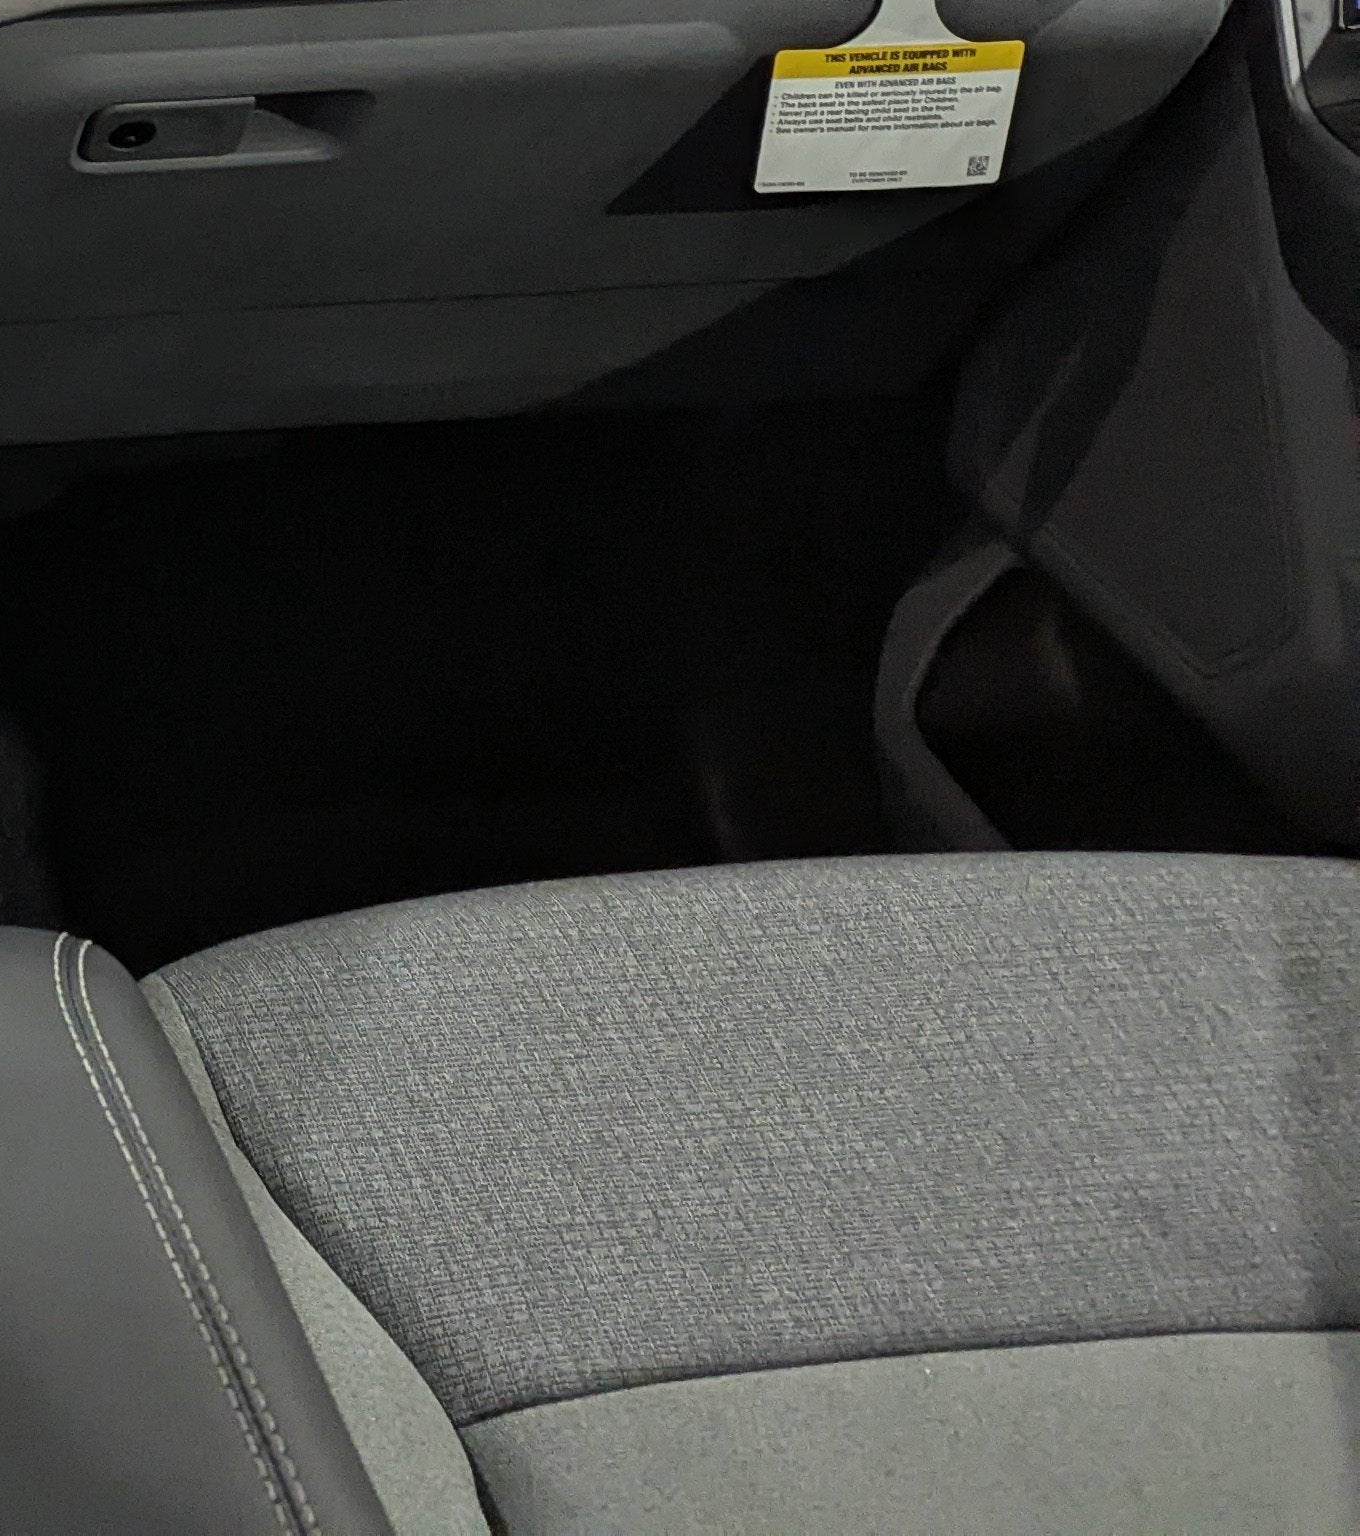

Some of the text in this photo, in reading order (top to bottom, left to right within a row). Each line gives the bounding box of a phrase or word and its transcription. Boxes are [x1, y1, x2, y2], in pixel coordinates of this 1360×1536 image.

[825, 48, 976, 63] THIS VEHICLE IS EQUIPPED WITH
[849, 62, 947, 74] ADVANCED AIR BAGS
